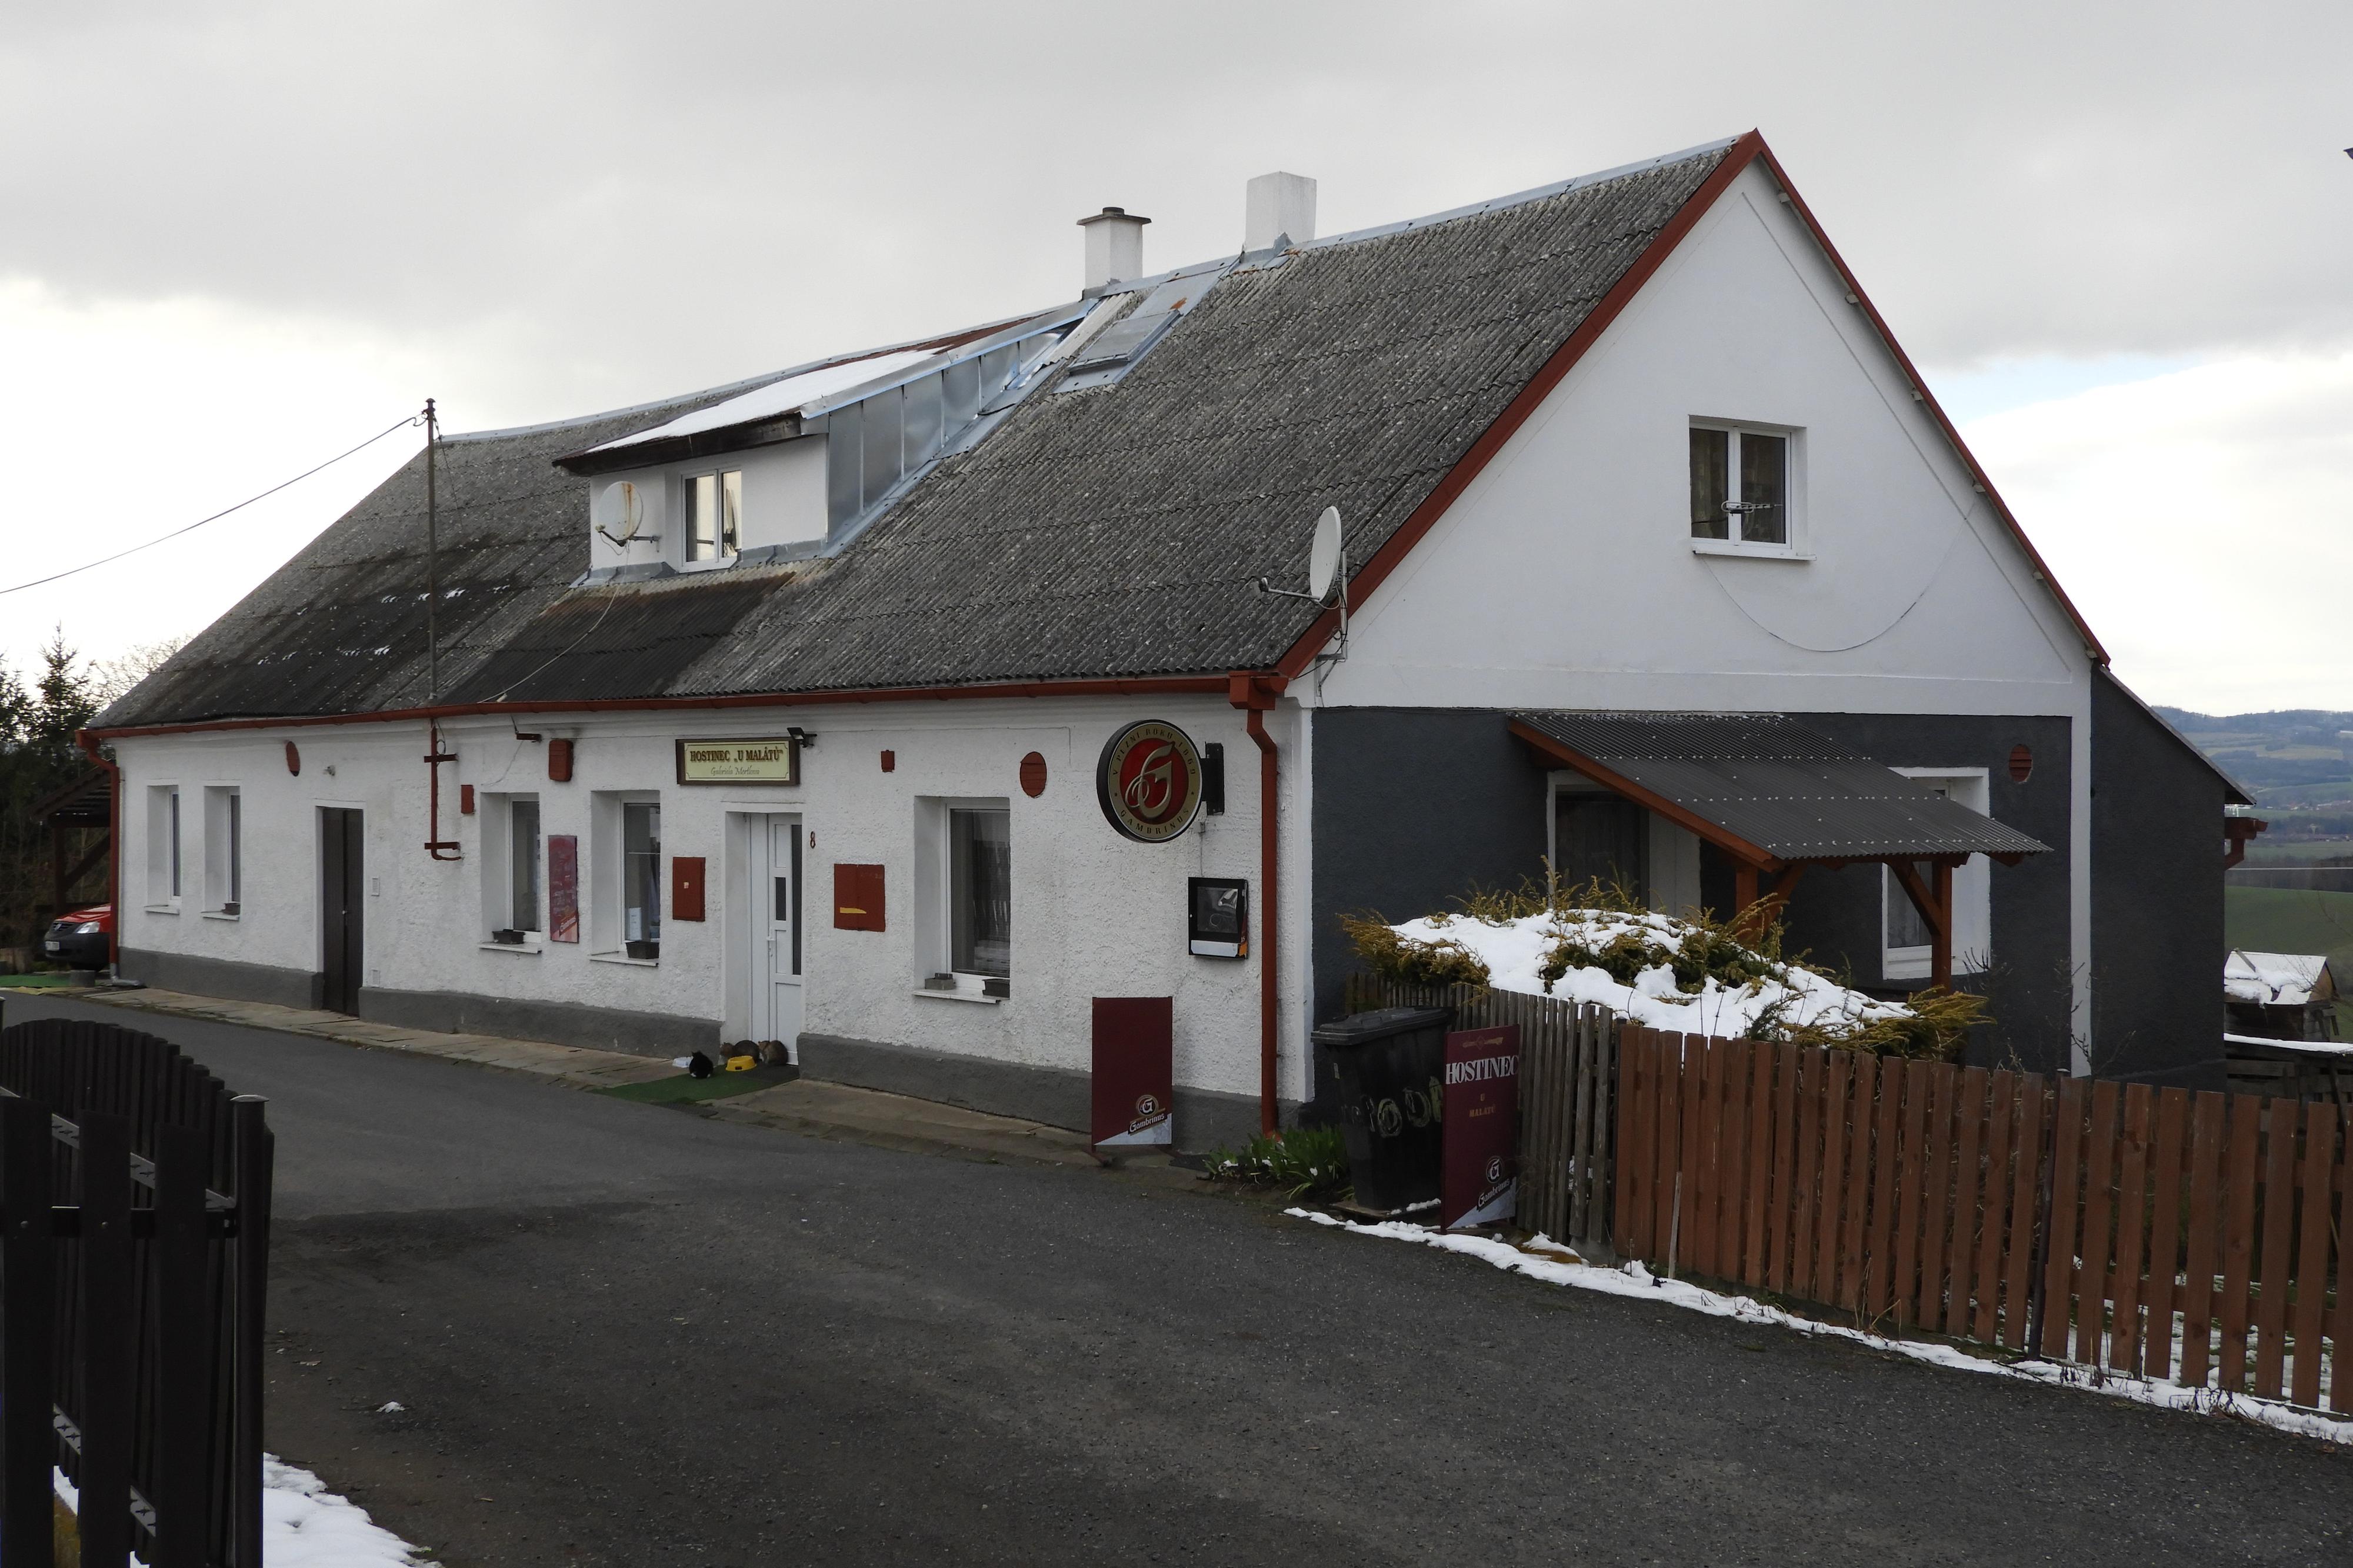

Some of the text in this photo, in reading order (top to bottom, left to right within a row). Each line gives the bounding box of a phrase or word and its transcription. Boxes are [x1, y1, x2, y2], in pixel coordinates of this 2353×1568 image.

[689, 750, 731, 762] HOSTINEC
[1120, 809, 1189, 835] GAMBRINUS
[810, 830, 816, 849] 8
[1445, 1055, 1519, 1085] HOSTINEC
[1129, 1113, 1165, 1133] Gambrinus
[1478, 1178, 1511, 1207] Gambrinus
